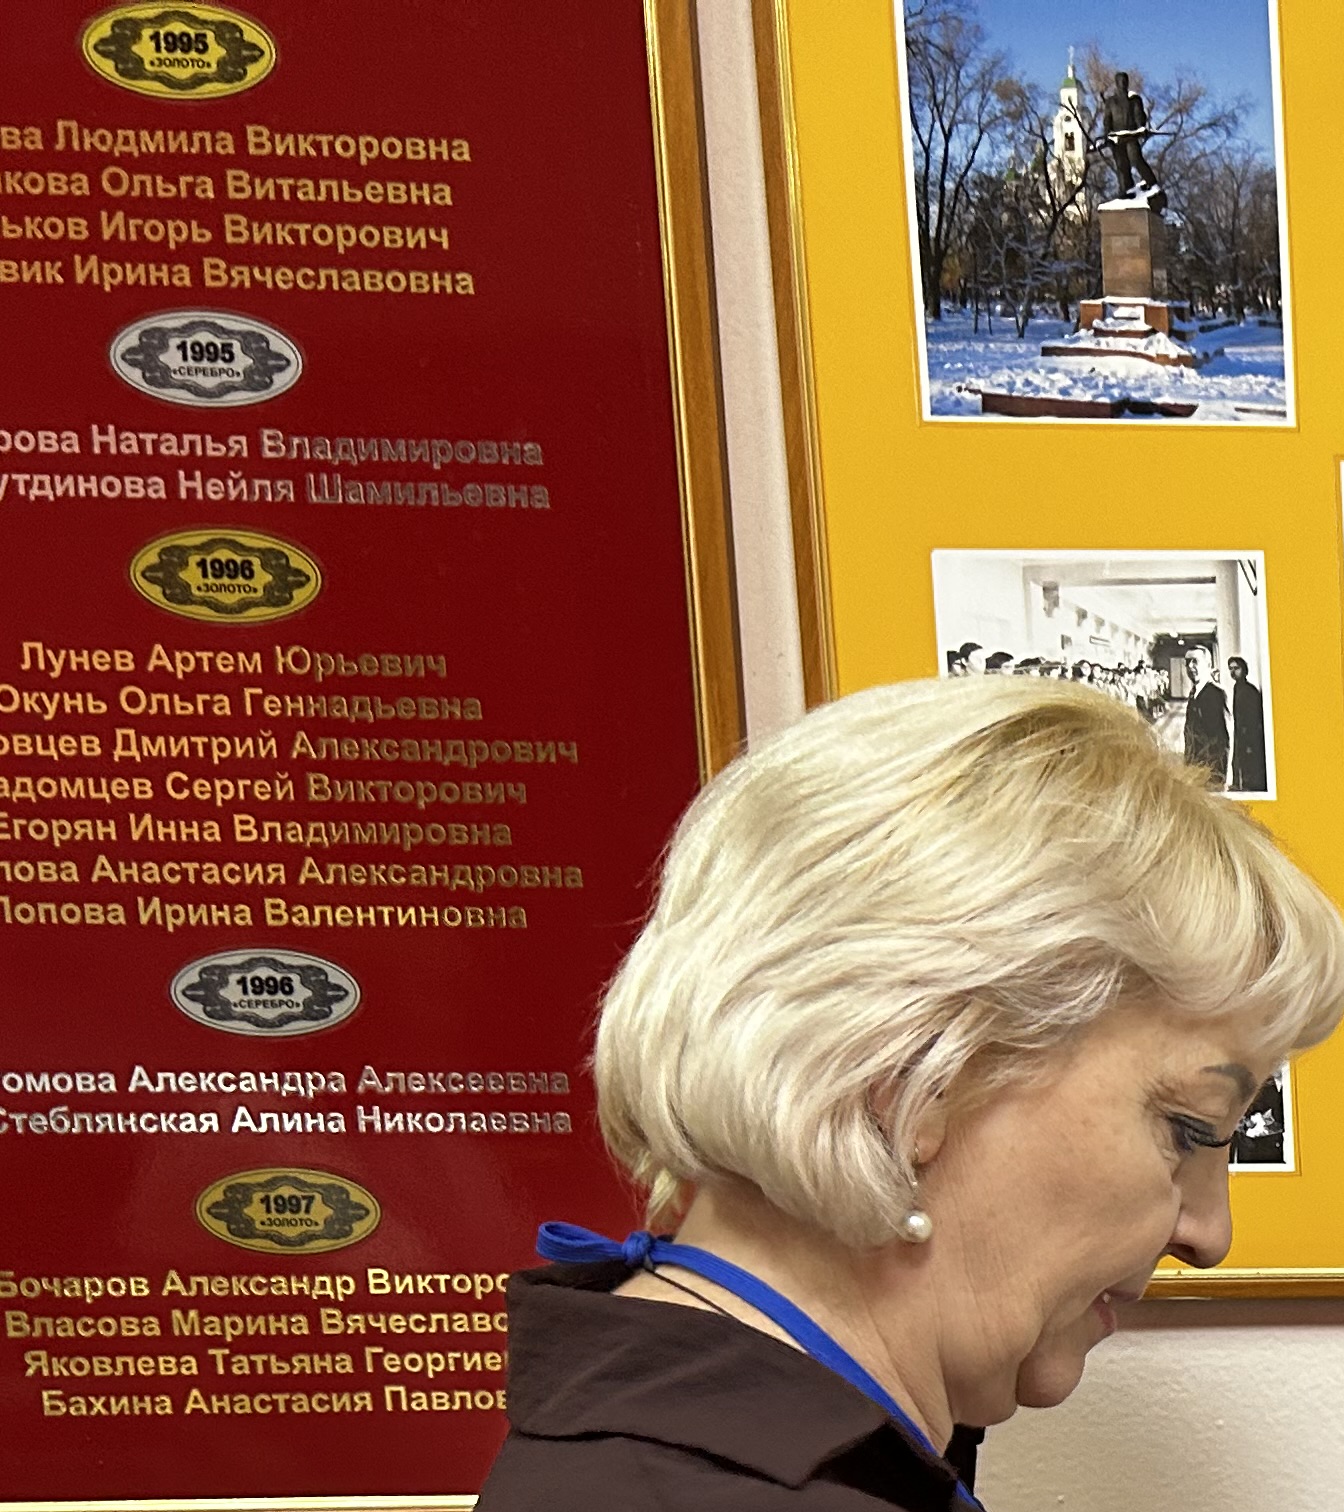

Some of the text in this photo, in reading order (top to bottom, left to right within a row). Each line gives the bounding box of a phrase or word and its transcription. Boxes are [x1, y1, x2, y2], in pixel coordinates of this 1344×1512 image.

[149, 30, 209, 55] 1995
[55, 119, 235, 157] Людмила
[246, 125, 471, 165] Викторовна
[0, 166, 452, 206] кова Ольга Витальевна
[1, 211, 449, 254] ьков Игорь Викторович
[0, 254, 475, 294] вик Ирина Вячеславовна
[176, 340, 235, 363] 1995
[92, 424, 248, 457] Наталья
[260, 428, 543, 470] Владимировна
[178, 470, 294, 502] Нейля
[306, 472, 550, 509] Шамильевна
[196, 557, 255, 581] 1996
[21, 642, 446, 682] Лунев Артем Юрьевич
[0, 684, 482, 722] Окунь Ольга Геннадьевна
[113, 728, 277, 764] Дмитрий
[290, 730, 578, 768] Александрович
[166, 771, 294, 807] Сергей
[306, 772, 526, 809] Викторович
[129, 813, 221, 842] Инна
[233, 814, 511, 850] Владимировна
[91, 855, 285, 885] Анастасия
[299, 856, 583, 892] Александровна
[137, 897, 253, 932] Ирина
[264, 898, 527, 927] Валентиновна
[236, 975, 294, 996] 1996
[2, 1065, 569, 1098] омова Александра Алексеевна
[0, 1106, 571, 1134] теблянская Алина Николаевна
[260, 1194, 315, 1215] 1997
[162, 1270, 355, 1301] Александр
[5, 1311, 161, 1337] Власова
[172, 1309, 309, 1342] Марина
[25, 1347, 508, 1378] Яковлева Татьяна Георгие
[42, 1390, 173, 1416] Бахина
[185, 1388, 373, 1414] Анастасия
